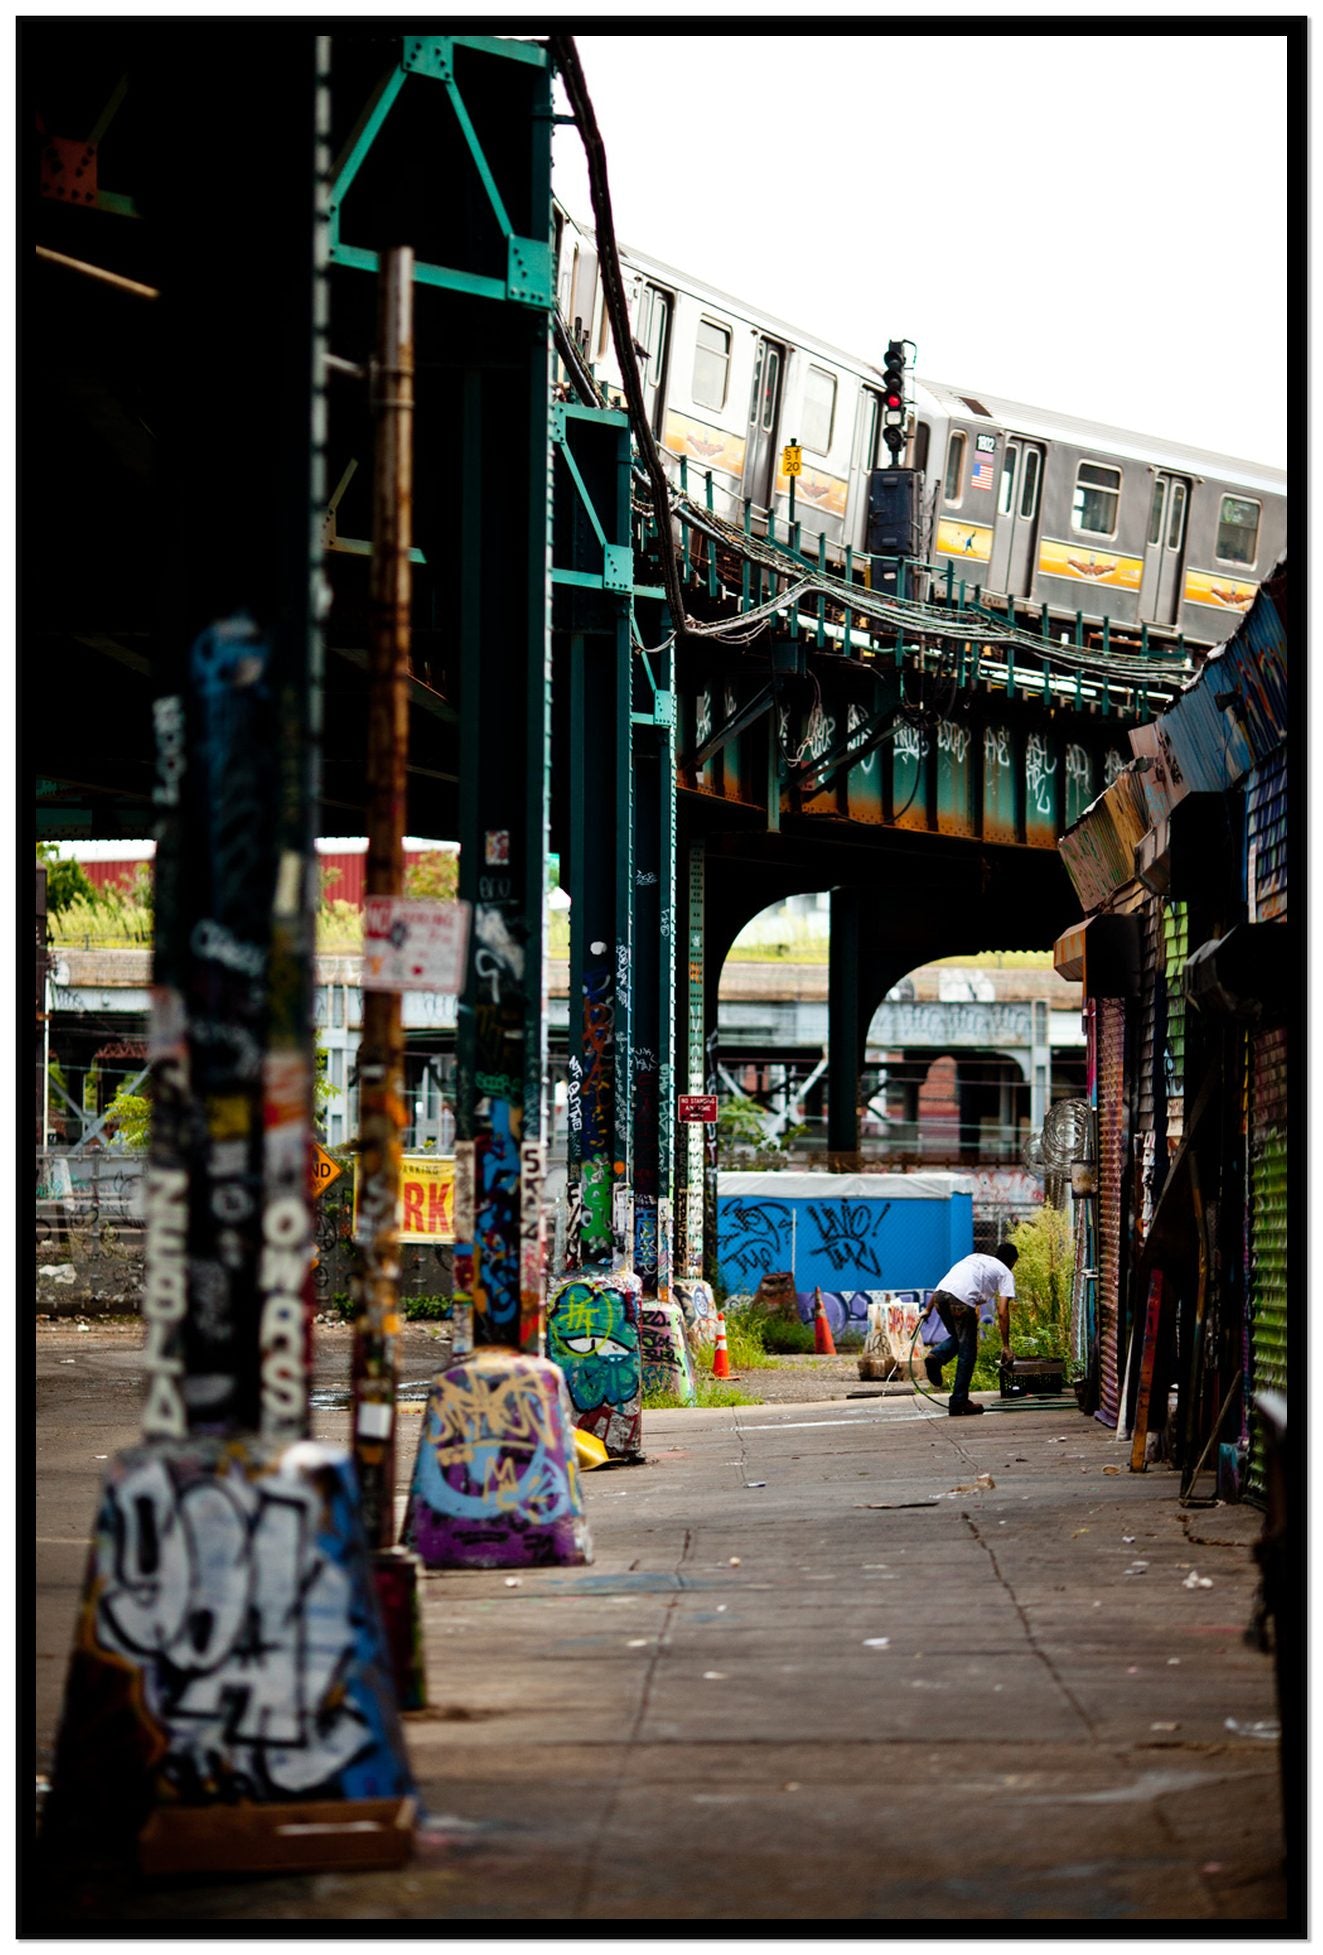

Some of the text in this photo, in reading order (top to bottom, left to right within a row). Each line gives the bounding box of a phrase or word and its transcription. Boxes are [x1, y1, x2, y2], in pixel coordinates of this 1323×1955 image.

[784, 450, 800, 461] ST
[785, 461, 800, 472] 20
[311, 1162, 331, 1178] ND
